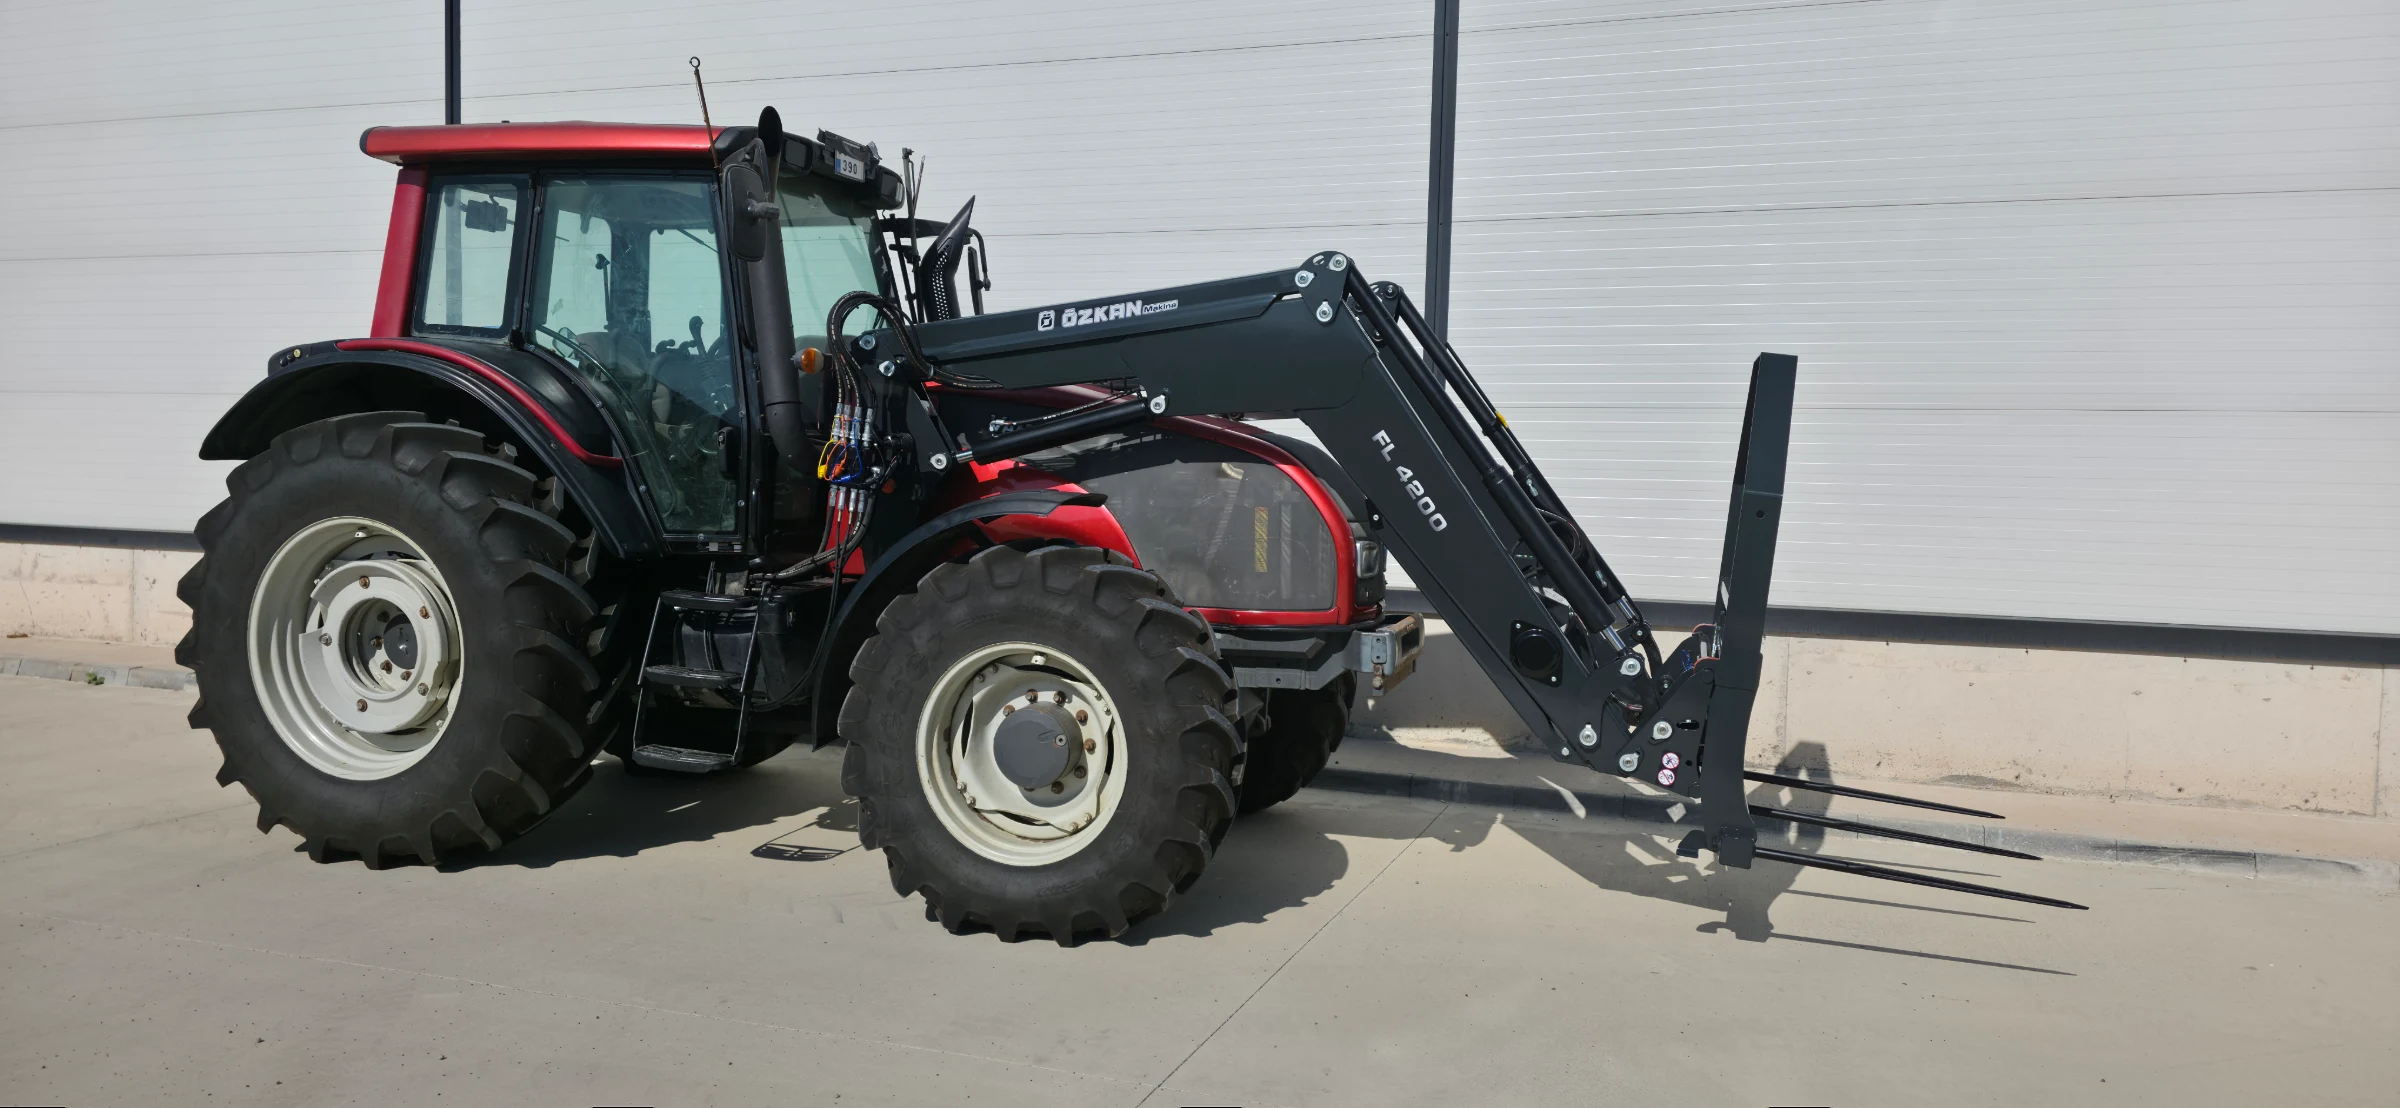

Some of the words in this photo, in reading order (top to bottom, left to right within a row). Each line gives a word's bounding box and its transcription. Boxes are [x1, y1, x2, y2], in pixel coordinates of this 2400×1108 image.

[843, 160, 858, 175] 390
[1061, 300, 1142, 328] ÖZKAN
[1144, 301, 1177, 313] Makina
[1371, 429, 1395, 462] FL
[1395, 465, 1448, 532] 4200
